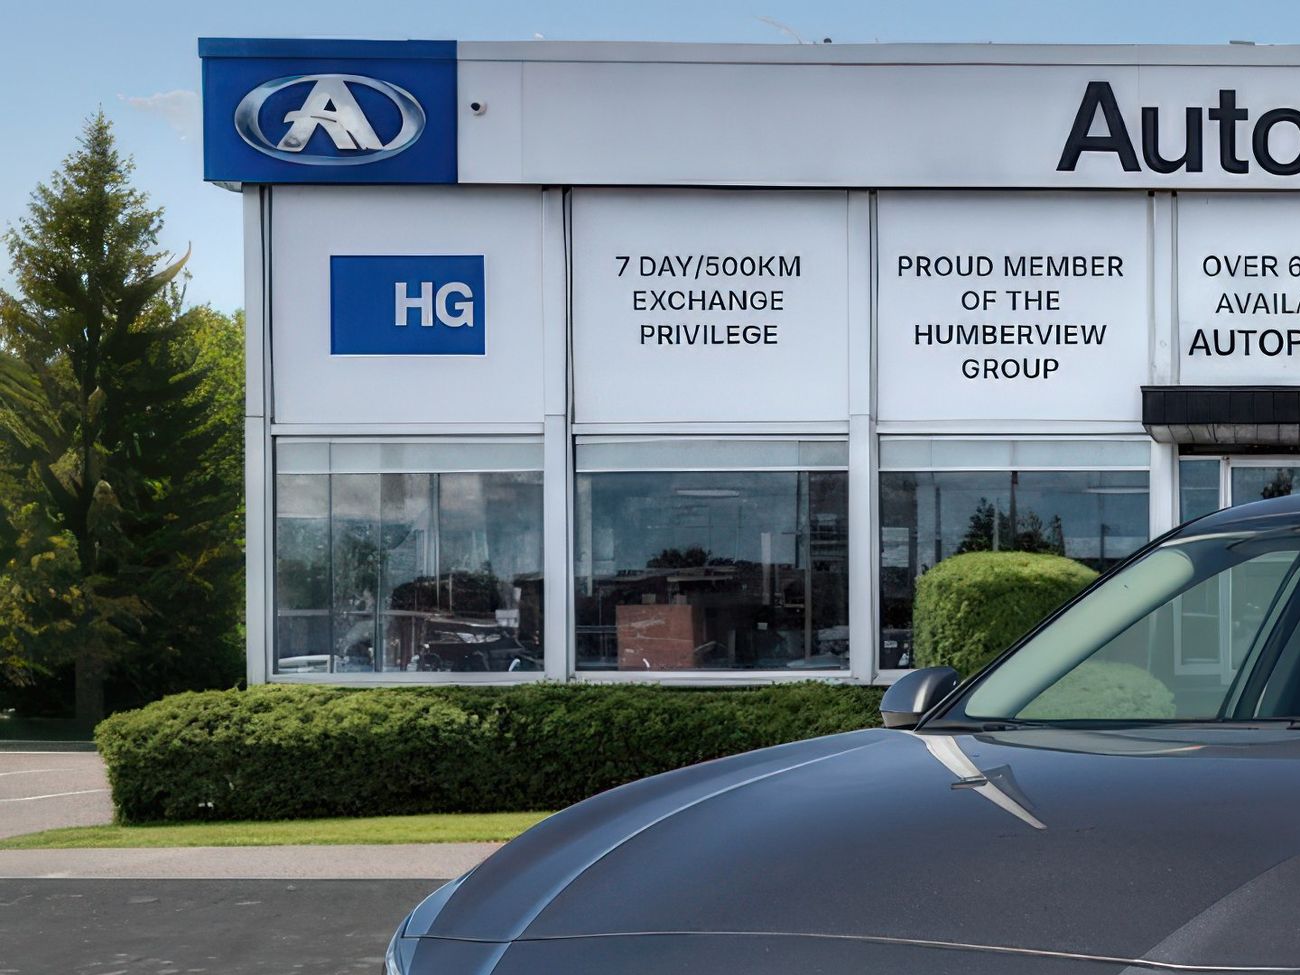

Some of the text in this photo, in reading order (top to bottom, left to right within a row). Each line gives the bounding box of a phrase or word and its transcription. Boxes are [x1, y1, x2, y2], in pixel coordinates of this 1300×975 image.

[616, 254, 802, 281] 7 DAY/500KM
[897, 255, 1124, 278] PROUD MEMBER
[1202, 254, 1280, 278] OVER
[395, 281, 474, 328] HG
[633, 289, 784, 312] EXCHANGE
[961, 289, 1061, 312] OF THE
[640, 324, 778, 346] PRIVILEGE
[914, 324, 1108, 346] HUMBERVIEW
[961, 357, 1060, 380] GROUP
